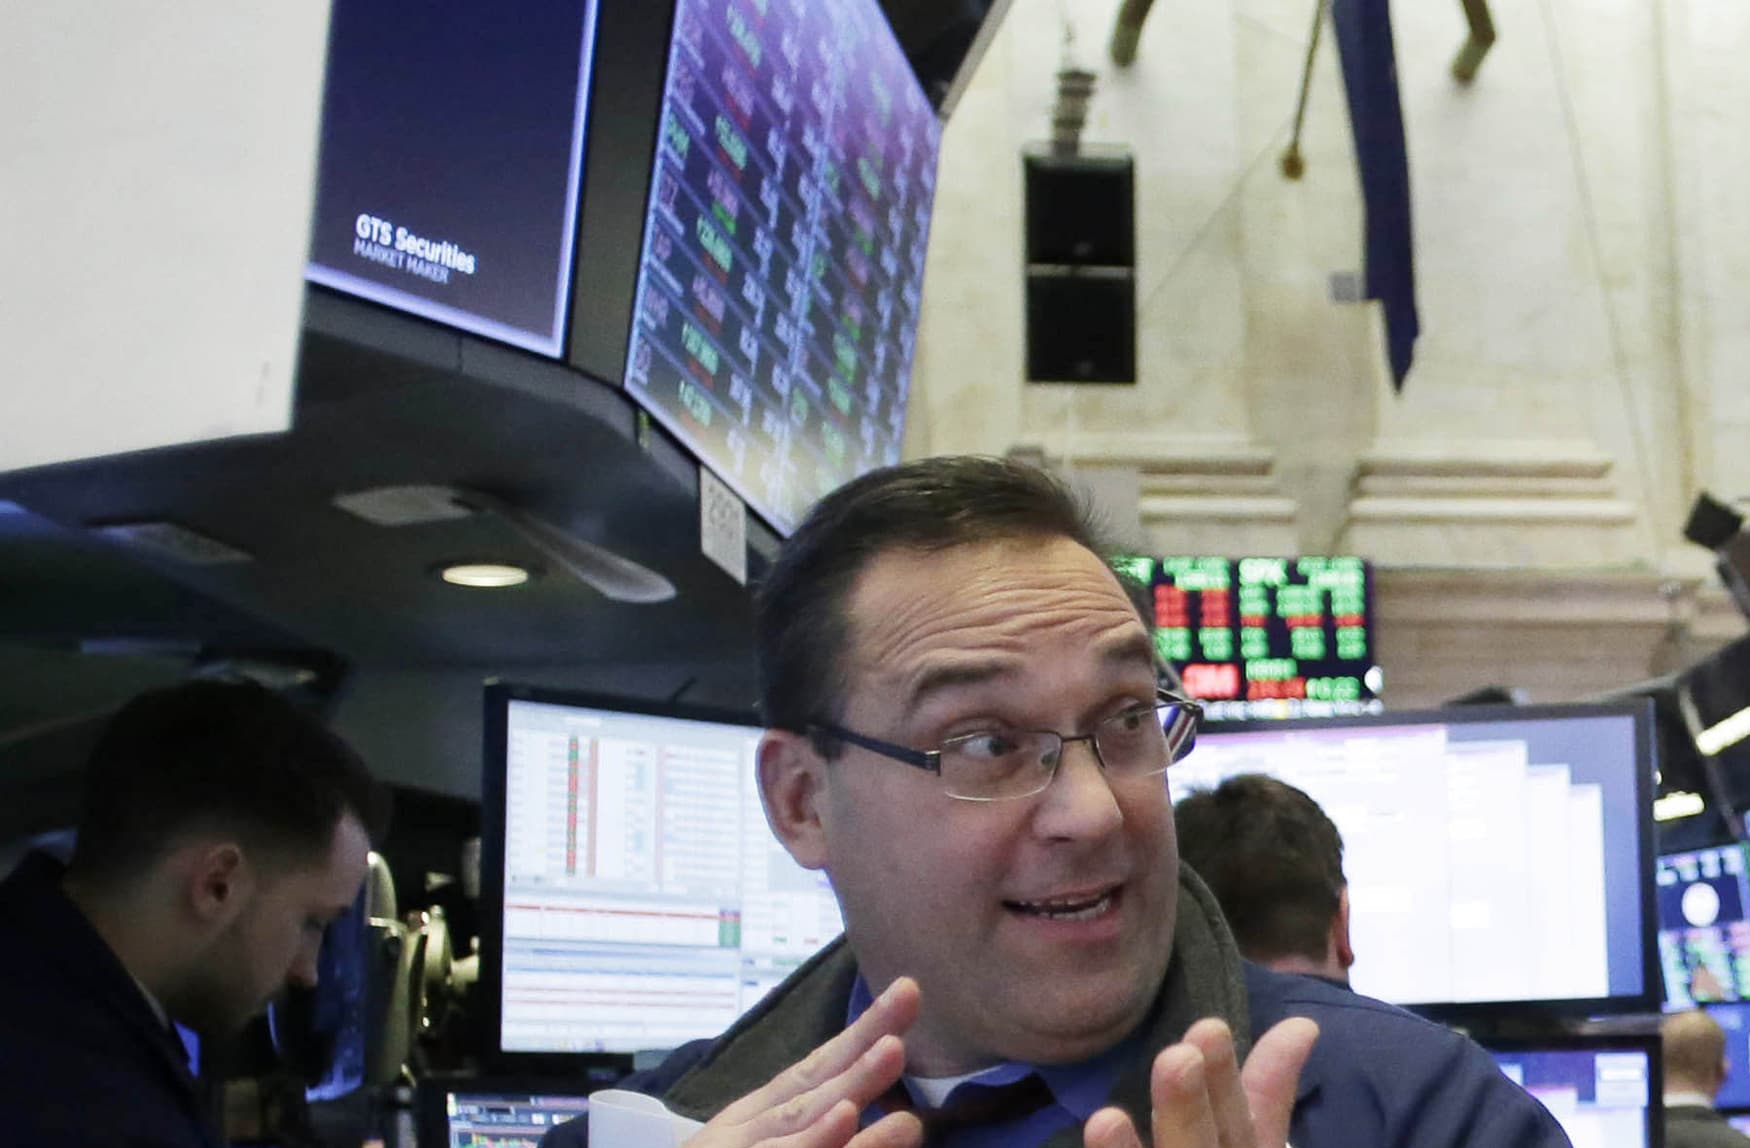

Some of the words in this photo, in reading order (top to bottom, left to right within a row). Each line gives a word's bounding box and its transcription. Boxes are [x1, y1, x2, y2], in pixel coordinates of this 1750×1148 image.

[353, 237, 405, 270] MARKET
[406, 254, 449, 284] MAKER
[355, 213, 393, 246] GTS
[395, 226, 476, 275] Securities
